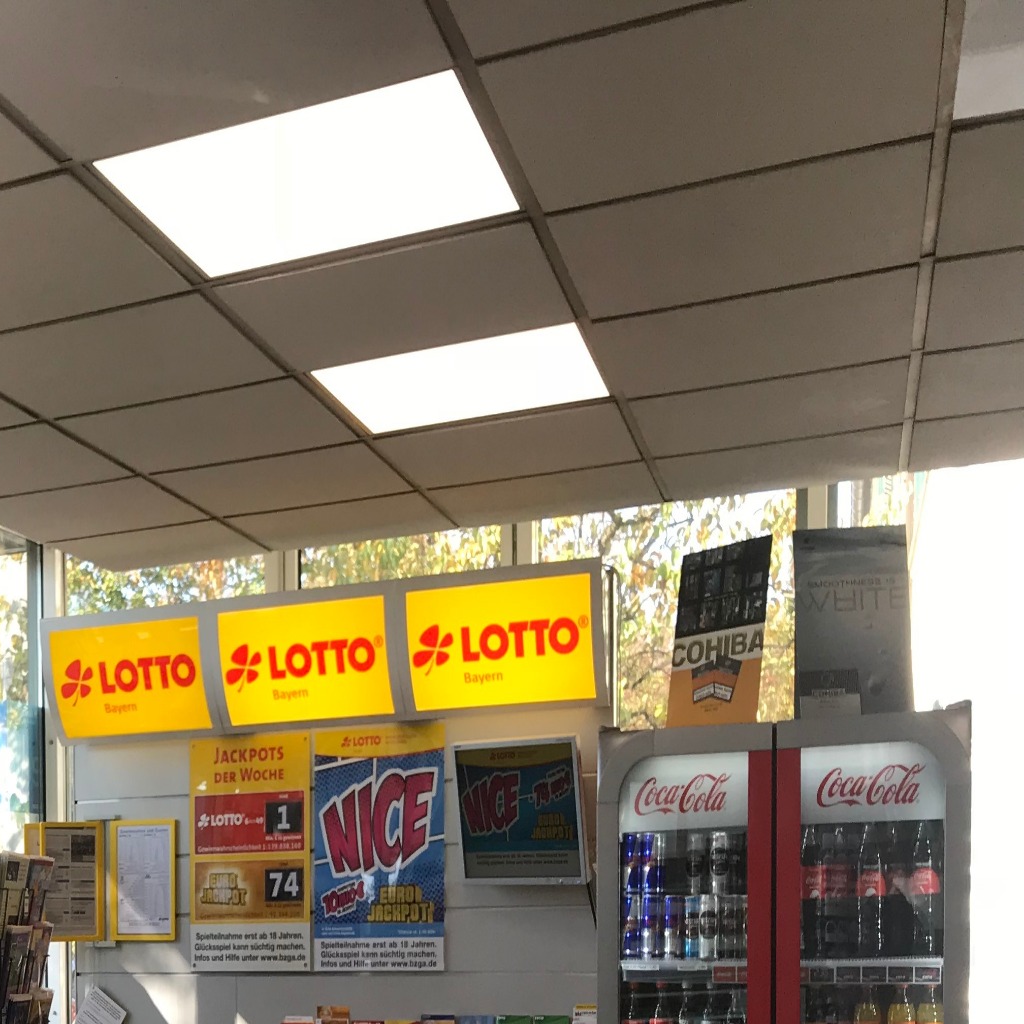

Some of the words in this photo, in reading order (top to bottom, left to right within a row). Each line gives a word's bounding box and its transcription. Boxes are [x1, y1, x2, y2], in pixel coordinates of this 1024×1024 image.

[461, 617, 580, 662] LOTTO
[268, 637, 376, 680] LOTTO
[672, 631, 764, 668] COHIBA
[98, 653, 196, 694] LOTTO
[464, 672, 504, 685] Bayern
[272, 688, 309, 702] Bayern
[104, 702, 138, 715] Bayern
[353, 735, 381, 747] LOTTO
[214, 746, 284, 764] JACKPOTS
[214, 772, 236, 784] DER
[240, 768, 284, 782] WOCHE
[817, 763, 926, 808] Coca-Cola
[461, 771, 520, 836] NICE
[634, 773, 732, 817] Coca-Cola
[211, 813, 243, 827] LOTTO
[277, 804, 291, 830] 1
[320, 768, 437, 876] NICE
[269, 871, 300, 898] 74
[379, 884, 422, 903] EURO
[367, 901, 434, 923] JACKPOT
[196, 932, 243, 942] Spielteilnahme
[244, 932, 258, 940] erst
[259, 931, 268, 940] ab
[269, 931, 277, 939] 18
[278, 931, 304, 940] Jahren.
[320, 941, 370, 950] Spielteilnahme
[389, 941, 398, 949] ab
[400, 941, 409, 949] 18
[410, 941, 437, 949] Jahren.
[194, 943, 231, 952] Glücksspiel
[233, 943, 249, 951] kann
[251, 943, 275, 953] süchtig
[277, 943, 306, 951] machen.
[320, 951, 360, 959] Glücksspiel
[361, 951, 378, 959] kann
[379, 951, 406, 960] süchtig
[407, 951, 437, 959] machen.
[194, 954, 211, 962] Infos
[211, 954, 224, 962] und
[225, 953, 240, 961] Hilfe
[242, 954, 259, 962] unter
[260, 953, 306, 962] www.bzga.de
[320, 960, 338, 968] Infos
[339, 960, 352, 968] und
[370, 960, 389, 968] unter
[390, 960, 437, 969] www.bzga.de
